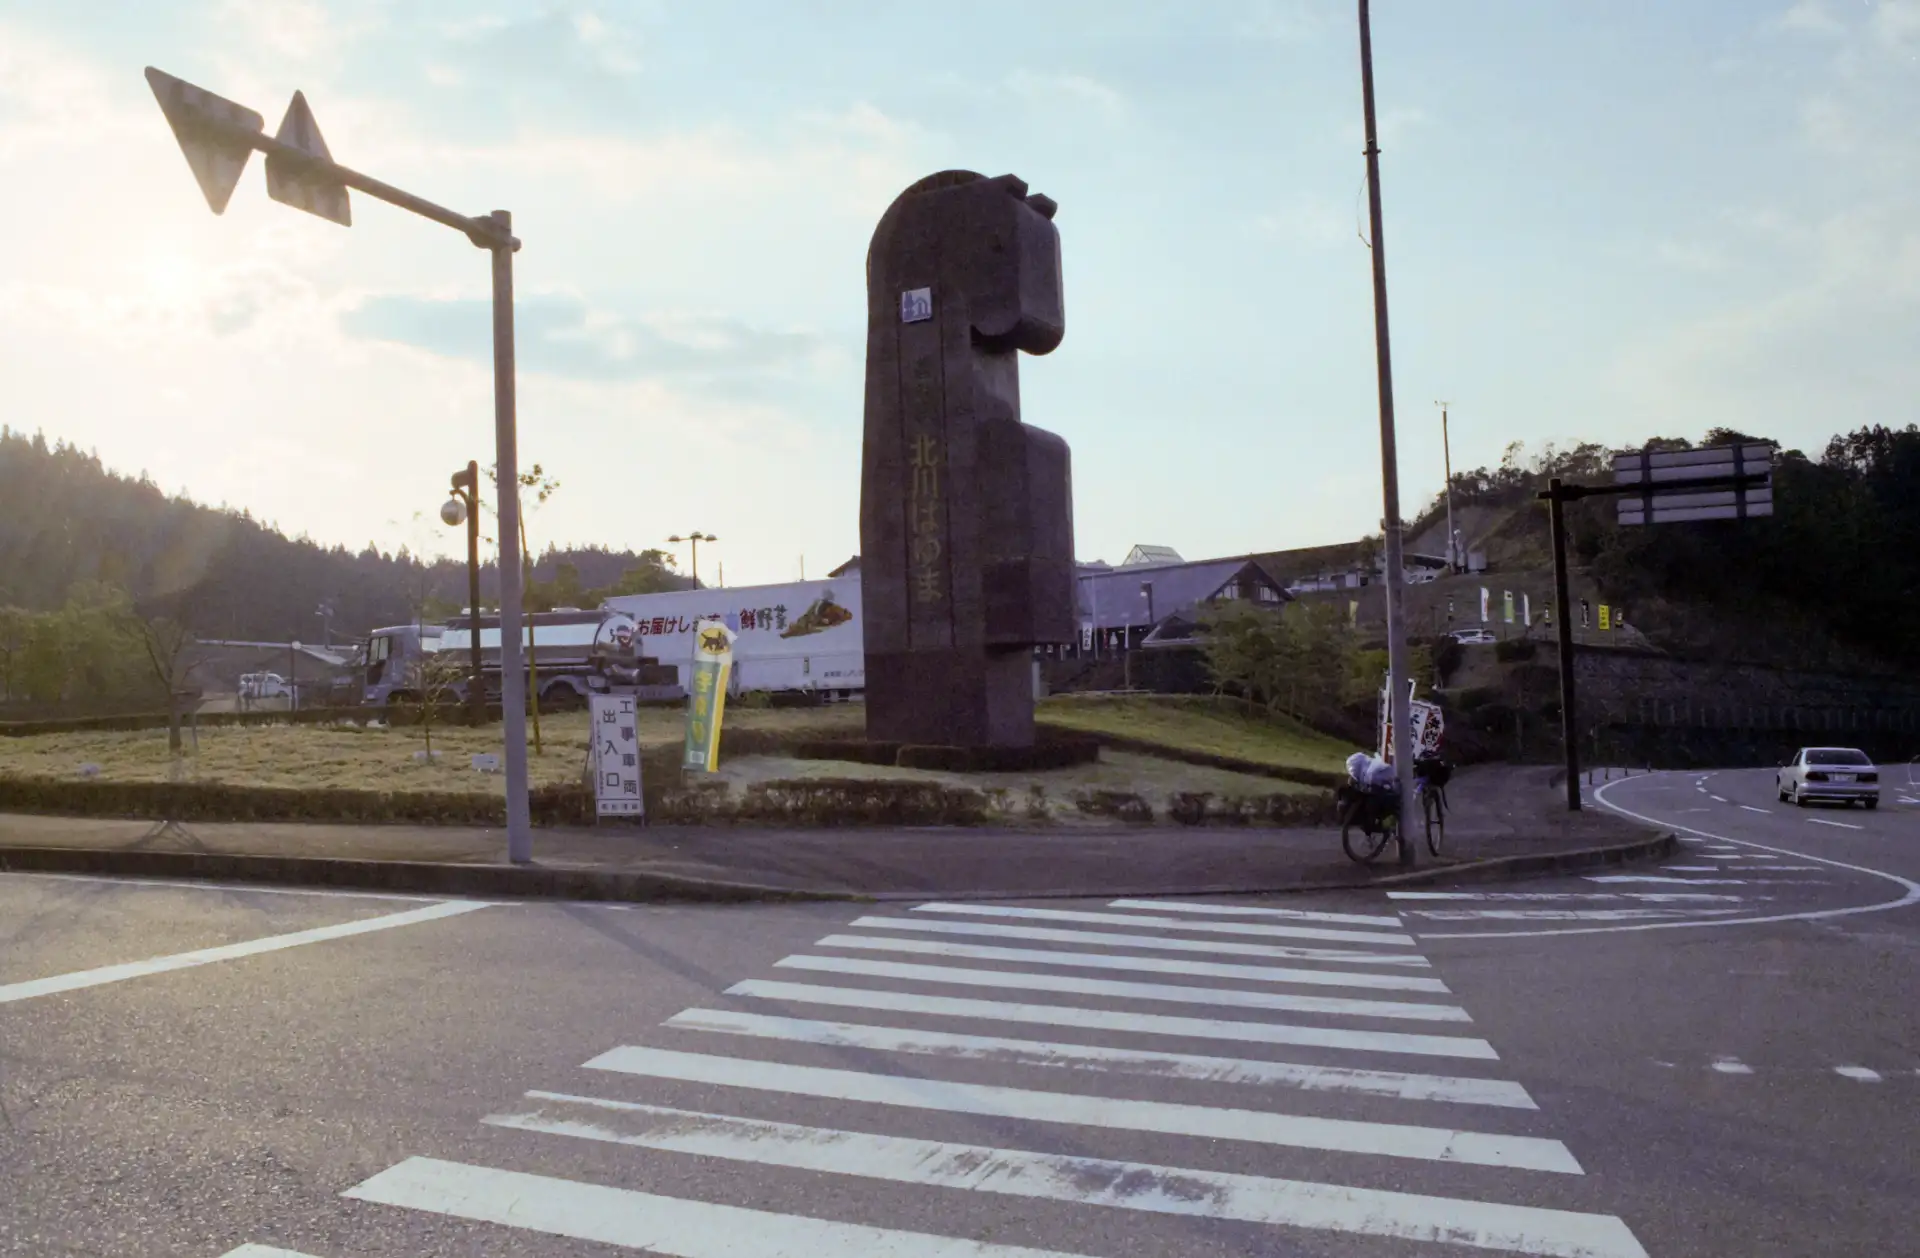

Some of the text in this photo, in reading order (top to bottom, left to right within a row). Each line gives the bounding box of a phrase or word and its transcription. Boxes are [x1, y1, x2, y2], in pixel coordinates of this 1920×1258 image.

[602, 709, 620, 787] 出入口
[619, 700, 637, 795] 工事車両
